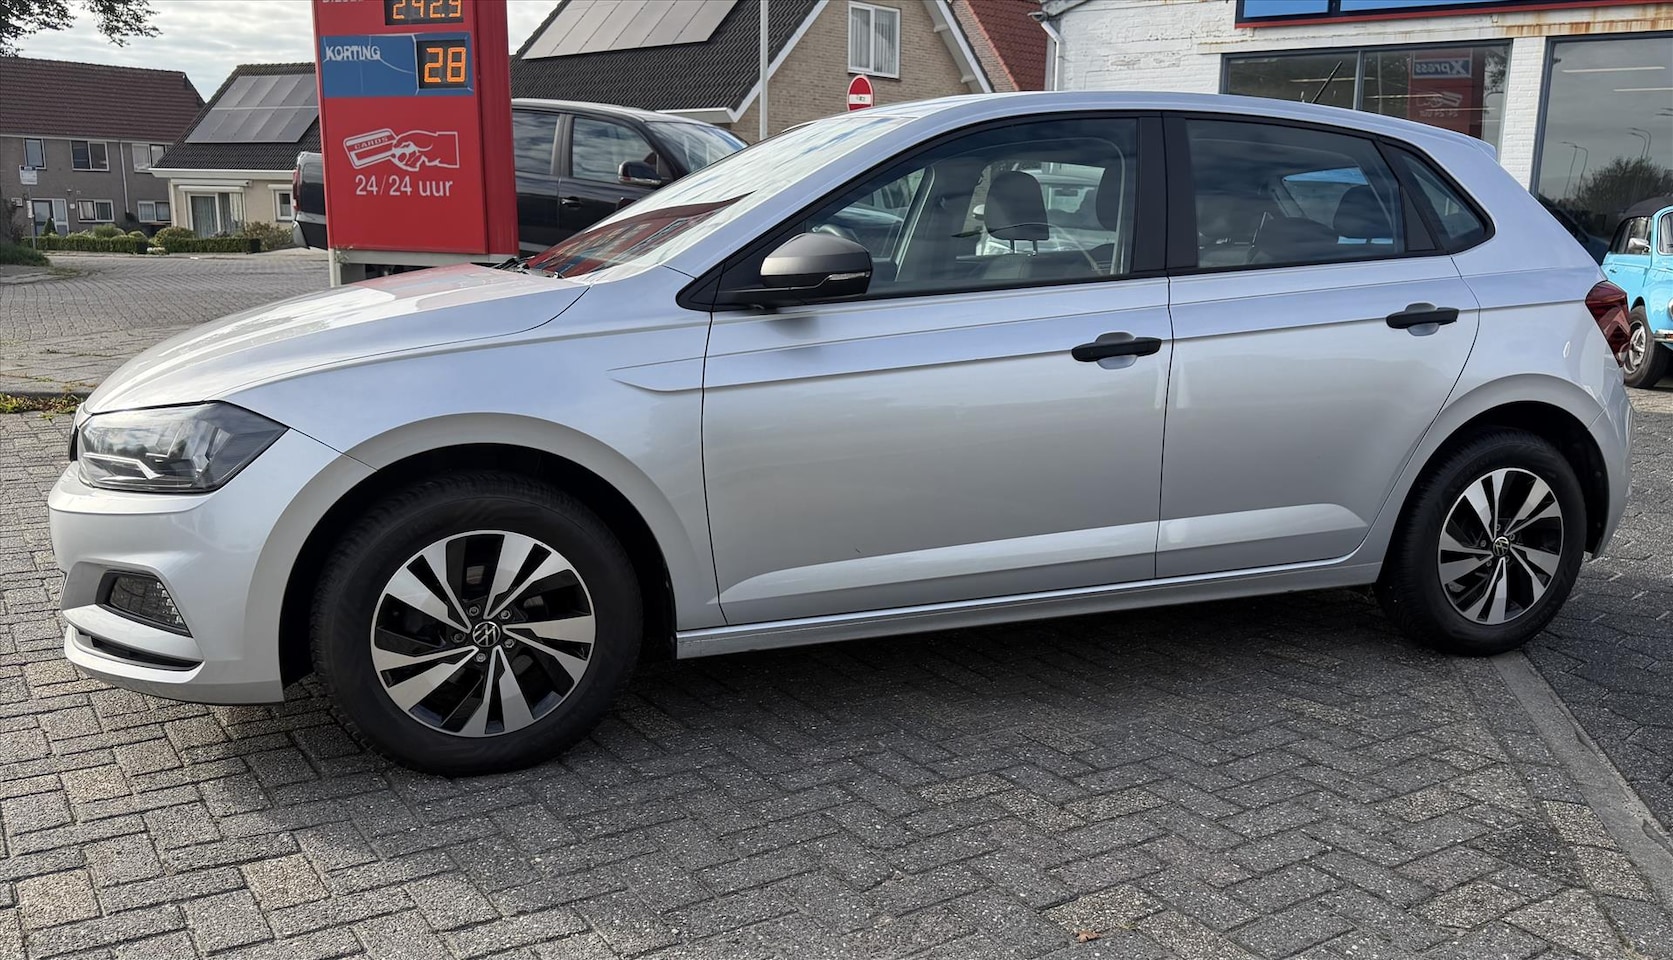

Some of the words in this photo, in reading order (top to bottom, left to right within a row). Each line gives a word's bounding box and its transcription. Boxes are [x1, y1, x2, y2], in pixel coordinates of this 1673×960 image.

[325, 45, 381, 60] KORTING
[424, 47, 467, 83] 28
[354, 136, 389, 150] CARDS
[355, 174, 412, 196] 24/24
[418, 180, 453, 196] uur
